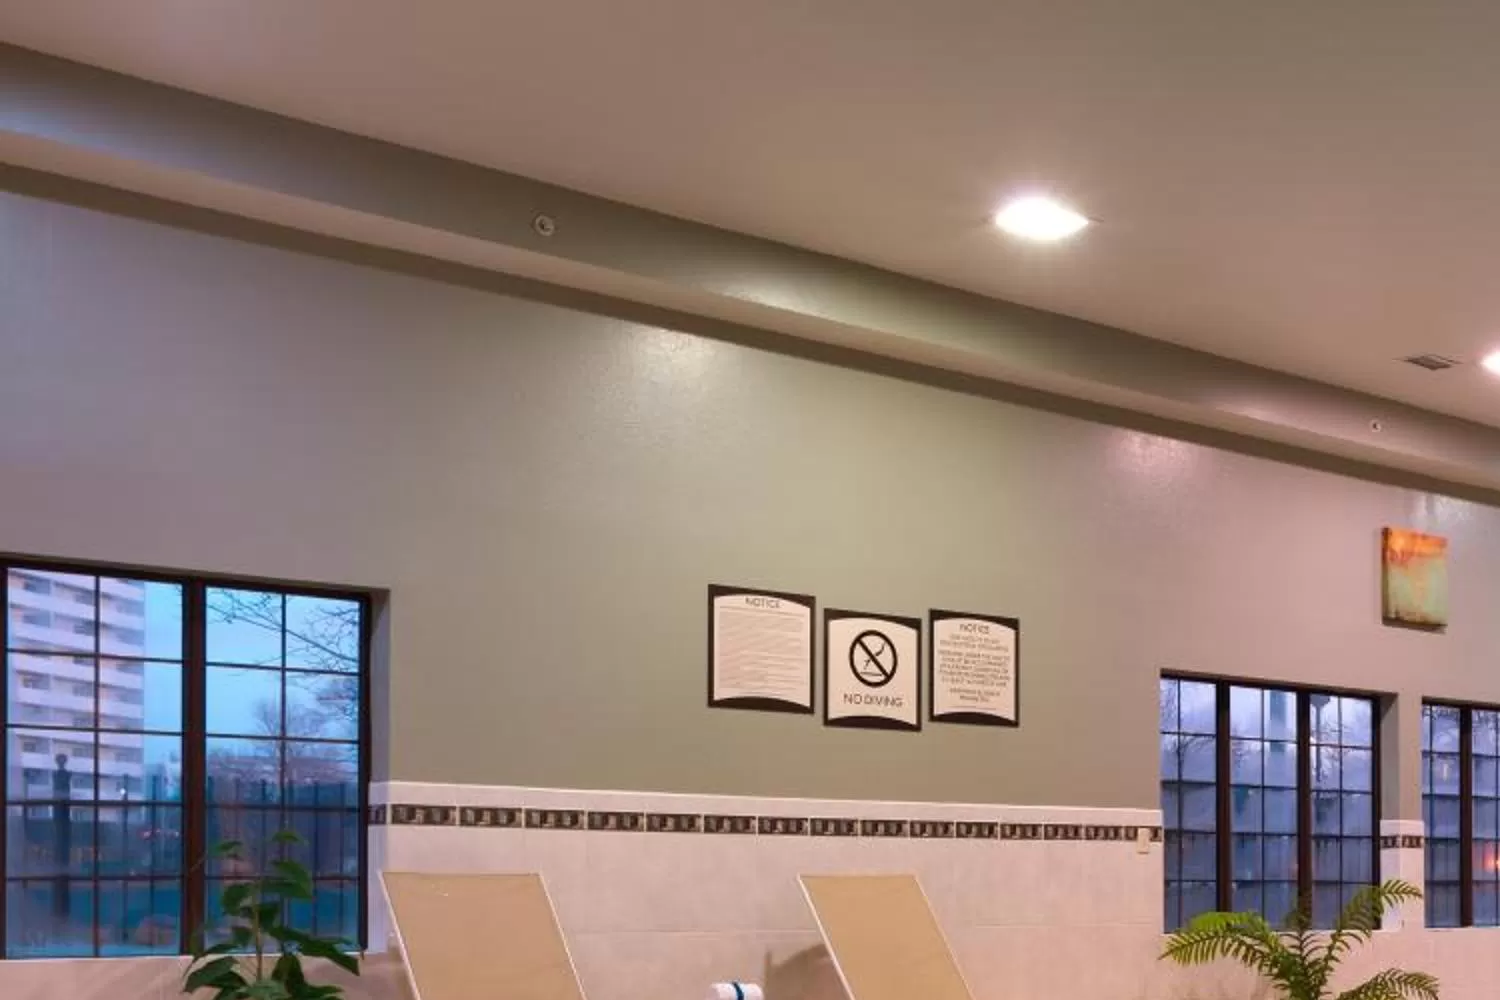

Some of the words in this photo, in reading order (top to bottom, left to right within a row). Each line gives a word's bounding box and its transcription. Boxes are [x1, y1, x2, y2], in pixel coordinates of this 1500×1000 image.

[745, 597, 783, 609] NOTICE
[843, 693, 862, 705] NO
[864, 694, 904, 708] DIVING
